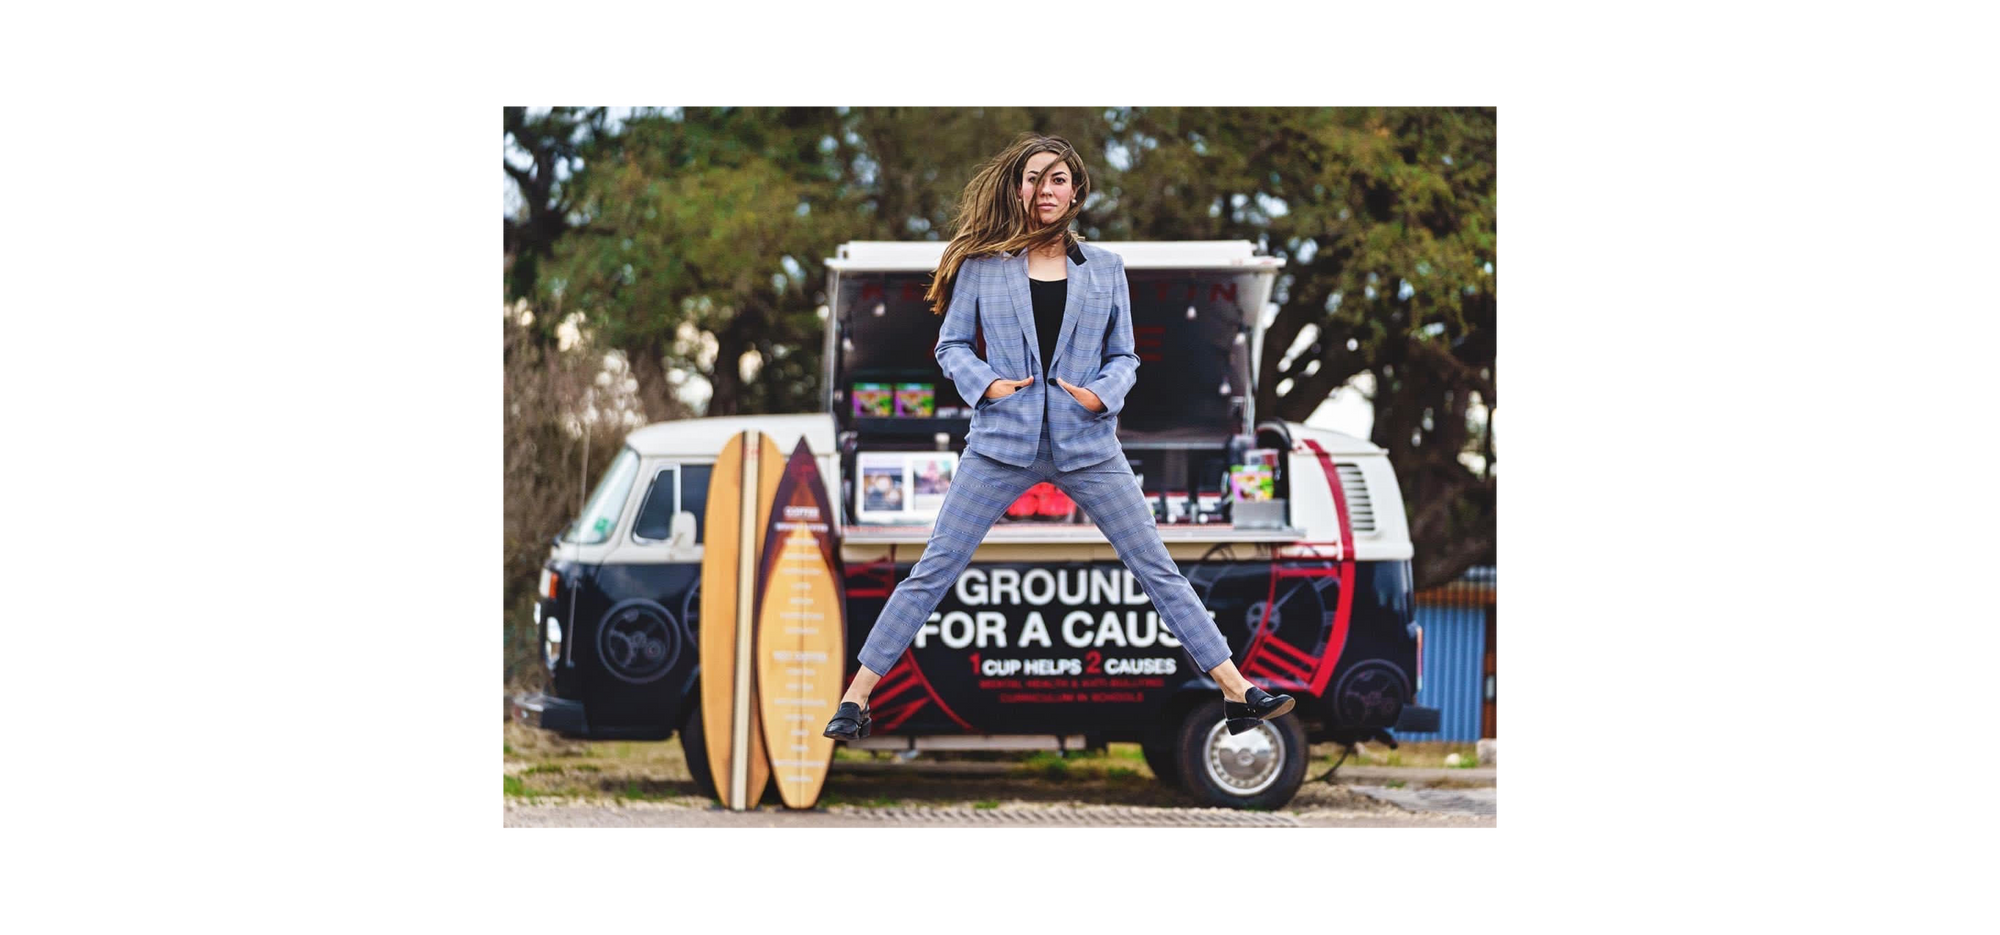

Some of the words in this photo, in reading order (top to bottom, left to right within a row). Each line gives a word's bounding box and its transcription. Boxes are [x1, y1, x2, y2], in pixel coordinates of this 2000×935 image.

[915, 610, 1007, 649] FOR
[1018, 610, 1053, 648] A
[968, 652, 981, 675] 1
[981, 658, 1022, 676] CUP
[1023, 658, 1083, 676] HELPS
[1085, 651, 1102, 674] 2
[1103, 658, 1178, 676] CAUSES
